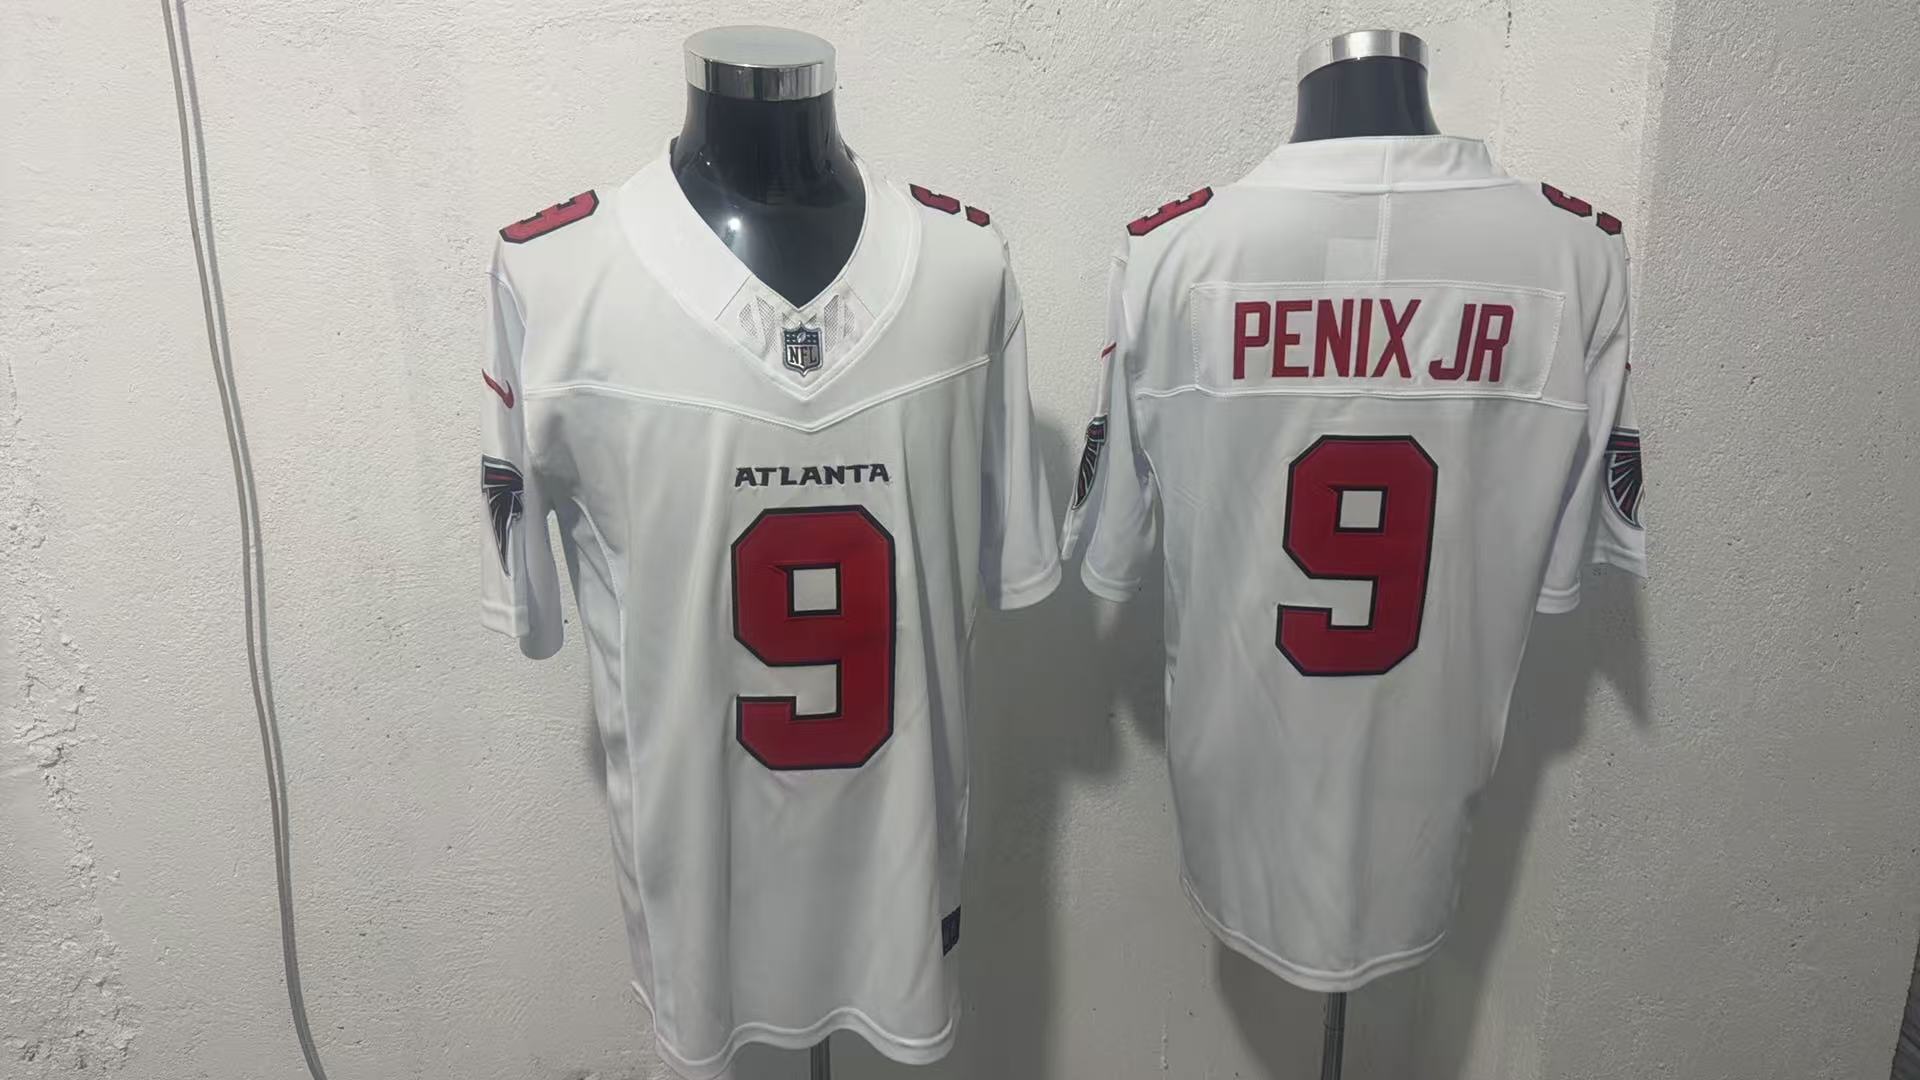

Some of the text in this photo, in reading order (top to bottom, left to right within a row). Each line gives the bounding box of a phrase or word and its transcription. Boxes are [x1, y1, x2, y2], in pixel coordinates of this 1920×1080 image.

[1233, 298, 1514, 382] PENIX JR
[734, 463, 890, 488] ATLANTA
[1275, 434, 1438, 677] 9
[731, 504, 896, 770] 9
